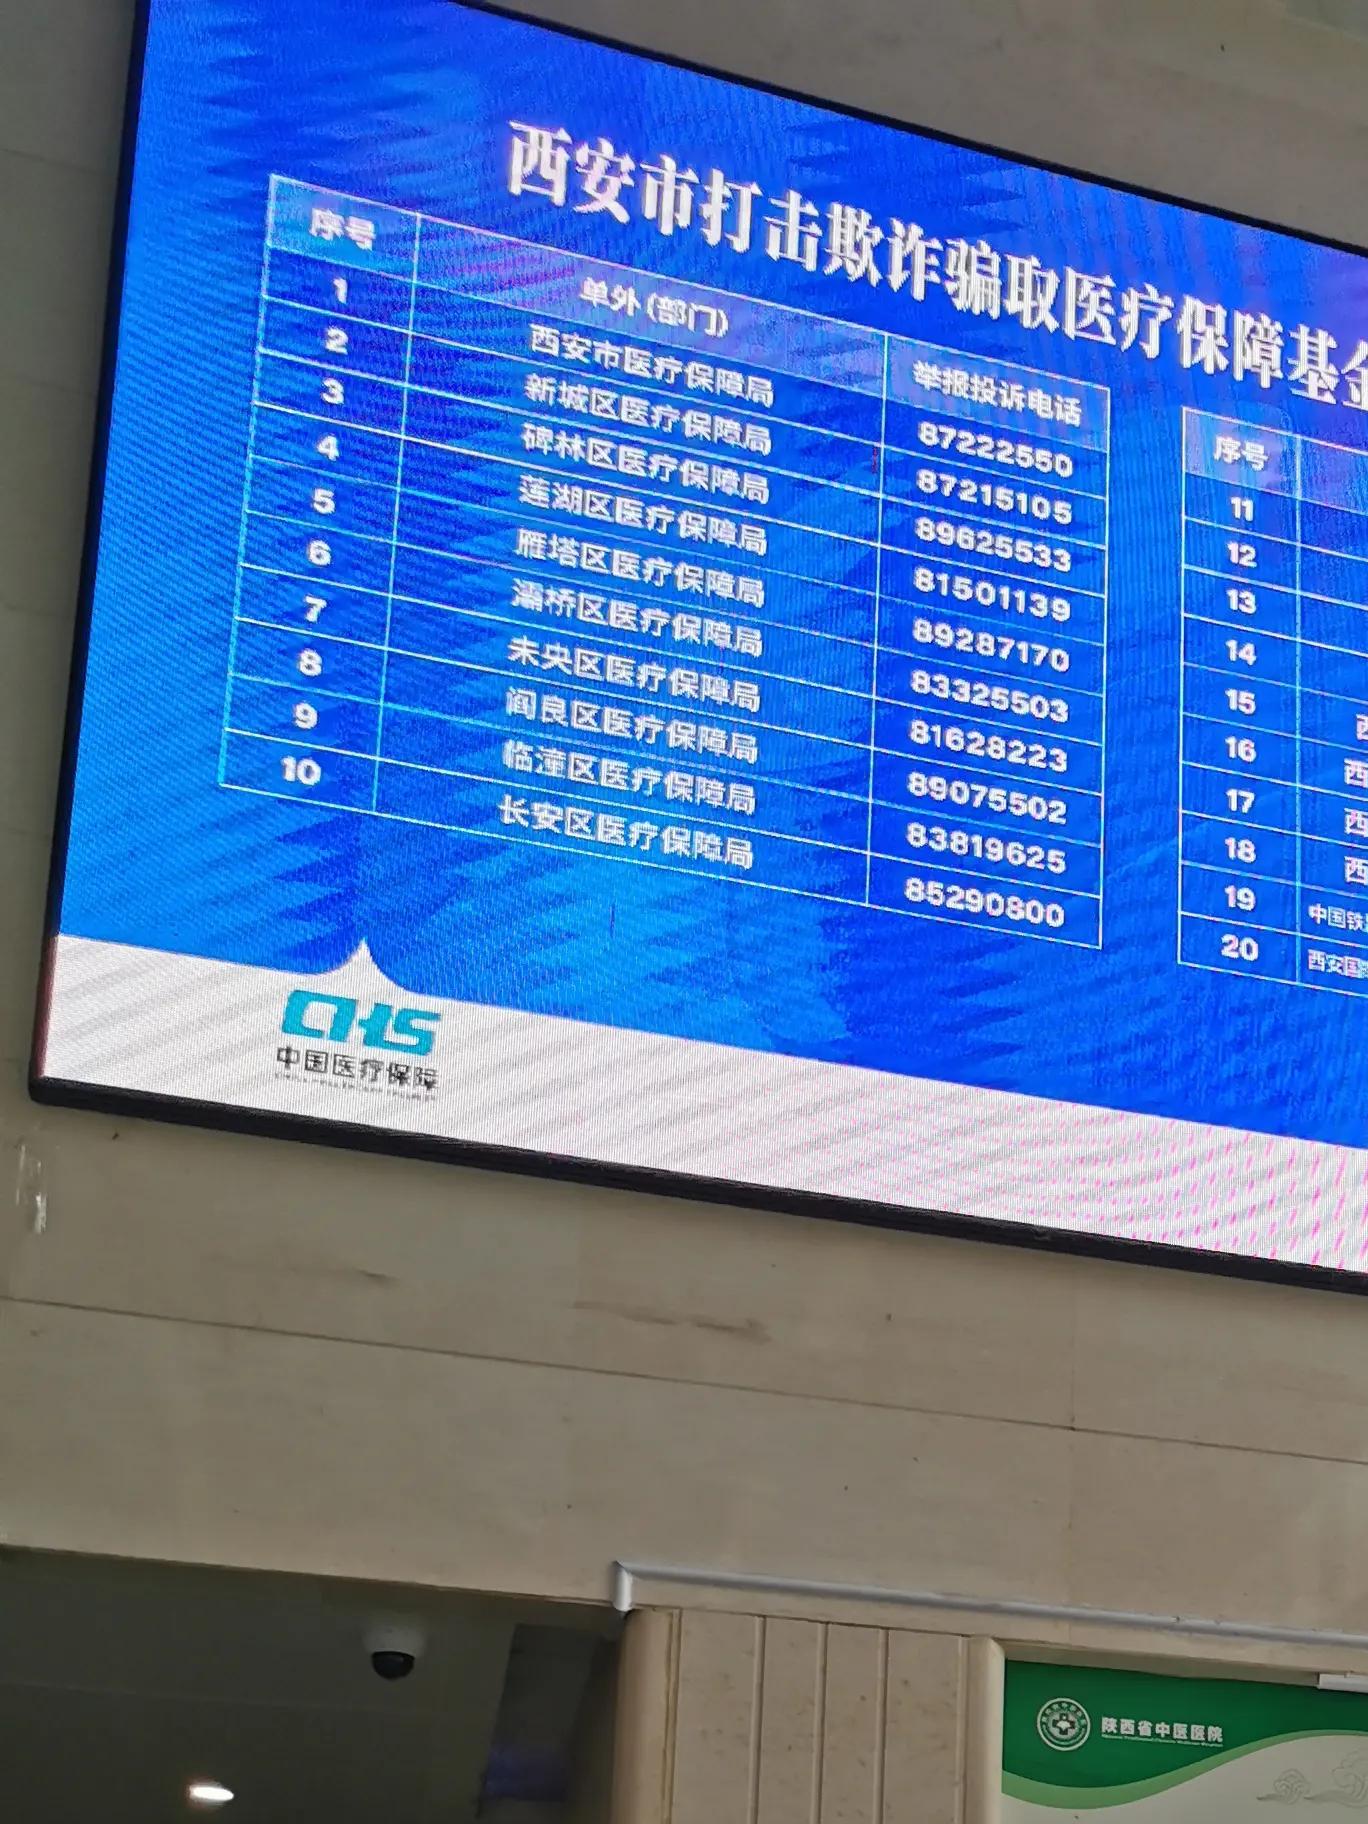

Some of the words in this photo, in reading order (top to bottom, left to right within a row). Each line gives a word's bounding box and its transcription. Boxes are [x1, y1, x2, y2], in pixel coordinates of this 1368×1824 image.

[310, 207, 376, 250] 序号
[333, 277, 348, 304] 1
[325, 329, 348, 355] 2
[529, 323, 774, 408] 西安市医疗保障局
[322, 378, 344, 405] 3
[912, 360, 1082, 427] 举报投诉电话
[524, 372, 773, 456] 新城区医疗保障局
[316, 433, 341, 461] 4
[521, 422, 771, 506] 碑林区医疗保障局
[917, 421, 1074, 478] 87222550
[1213, 436, 1269, 471] 序号
[313, 488, 336, 515] 5
[519, 475, 768, 557] 莲湖区医疗保障局
[916, 468, 1072, 525] 87215105
[1231, 497, 1254, 522] 11
[308, 538, 331, 567] 6
[915, 516, 1071, 573] 89625533
[1227, 541, 1257, 568] 12
[515, 527, 766, 609] 雁塔区医疗保障局
[304, 595, 327, 623] 7
[913, 566, 1070, 622] 81501139
[1226, 588, 1257, 614] 13
[512, 579, 763, 658] 灞桥区医疗保障局
[298, 649, 323, 677] 8
[912, 617, 1069, 673] 89287170
[1225, 638, 1257, 666] 14
[507, 635, 761, 713] 未央区医疗保障局
[294, 701, 318, 730] 9
[910, 668, 1069, 724] 83325503
[1224, 688, 1257, 715] 15
[505, 686, 759, 766] 阎良区医疗保障局
[909, 719, 1068, 773] 81628223
[1224, 735, 1257, 762] 16
[280, 755, 322, 787] 10
[502, 739, 756, 815] 临潼区医疗保障局
[906, 771, 1067, 825] 89075502
[1225, 789, 1255, 815] 17
[498, 794, 754, 871] 长安区医疗保障局
[905, 821, 1066, 874] 83819625
[1224, 836, 1256, 864] 18
[904, 876, 1065, 928] 85290800
[1224, 884, 1256, 912] 19
[1220, 934, 1258, 962] 20
[276, 1046, 440, 1090] 中国医疗保障
[1101, 1716, 1223, 1743] 陕西省中医医院
